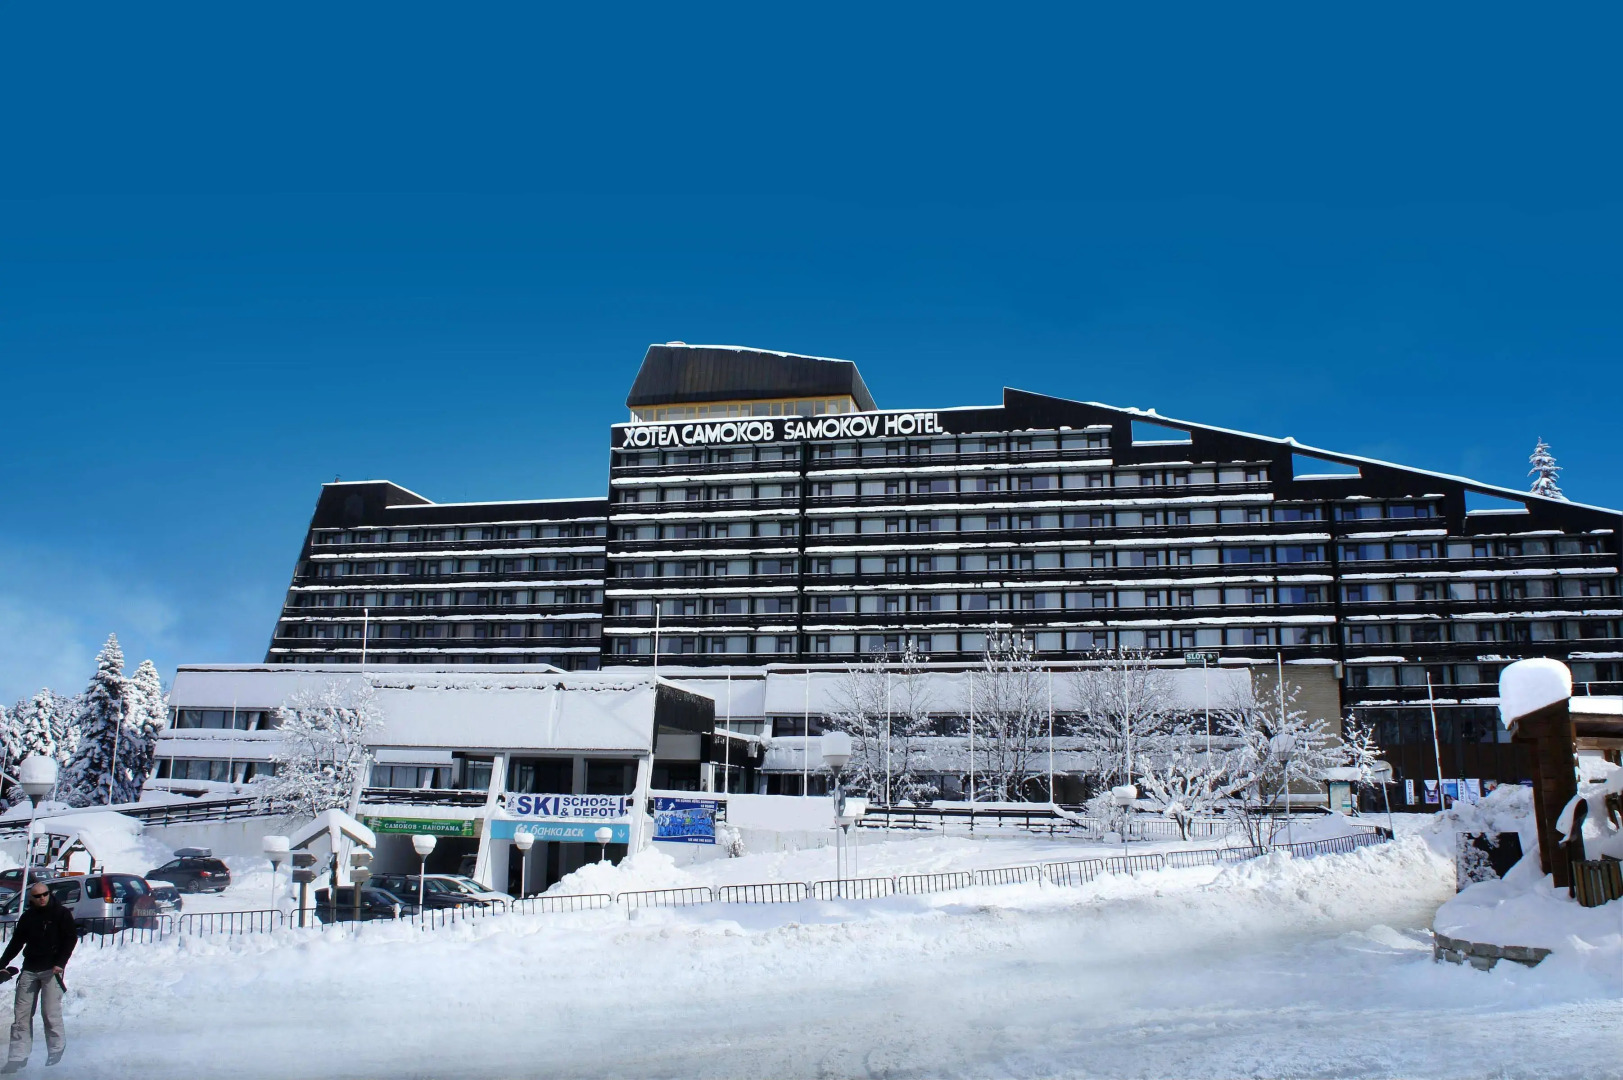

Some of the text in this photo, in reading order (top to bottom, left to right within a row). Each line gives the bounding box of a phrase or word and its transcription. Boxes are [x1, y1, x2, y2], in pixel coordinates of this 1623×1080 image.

[623, 421, 774, 447] ХОТЕЛ САМОКОВ
[784, 412, 944, 440] SAMOKOV HOTEL
[517, 795, 560, 815] SKI
[560, 807, 616, 817] & DEPOT
[563, 797, 616, 807] SCHOOL
